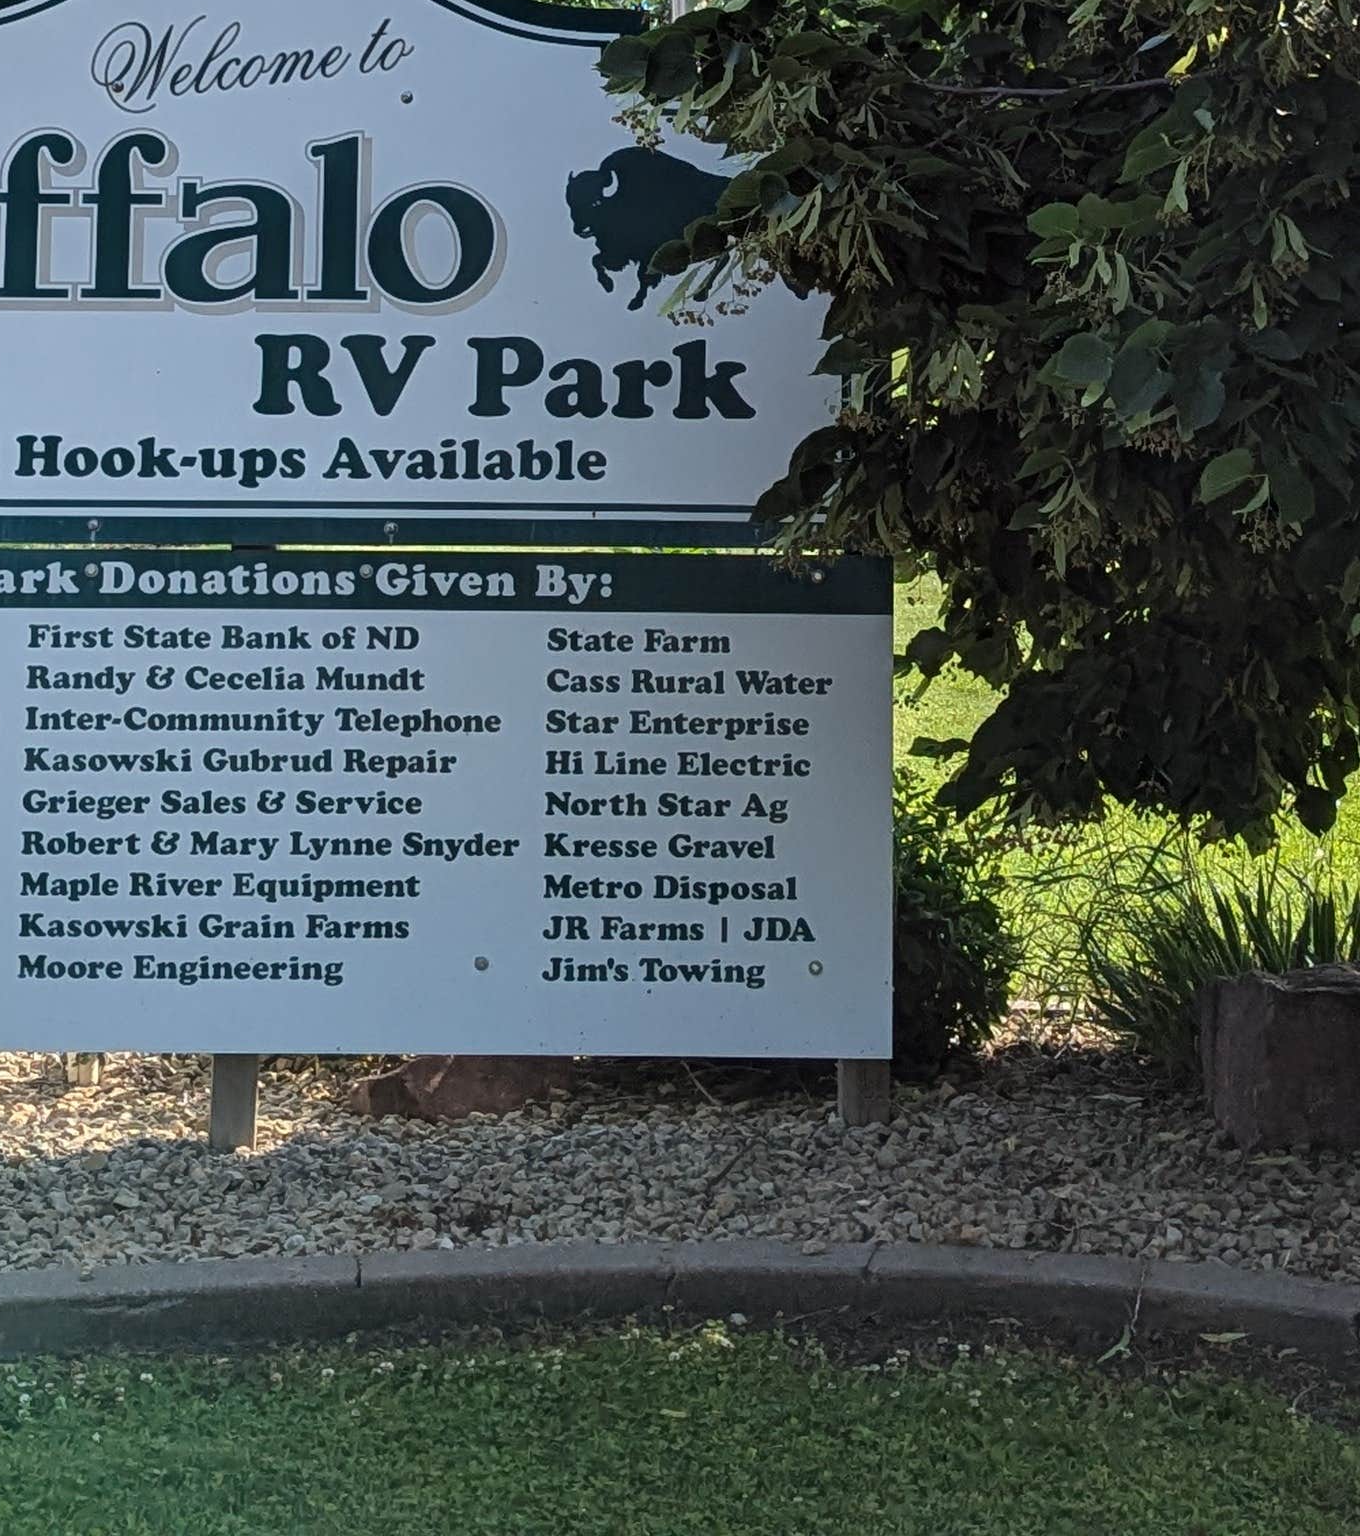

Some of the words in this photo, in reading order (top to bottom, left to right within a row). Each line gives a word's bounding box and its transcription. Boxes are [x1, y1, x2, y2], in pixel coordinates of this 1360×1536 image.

[90, 14, 352, 114] Welcome
[357, 17, 415, 75] to
[252, 333, 437, 417] RV
[466, 336, 757, 420] Park
[14, 434, 306, 489] Hook-ups
[322, 437, 607, 481] Available
[98, 561, 356, 596] Donations
[375, 562, 516, 597] Given
[535, 564, 612, 605] By:
[27, 623, 114, 649] First
[123, 624, 212, 650] State
[221, 625, 312, 650] Bank
[321, 625, 357, 650] of
[366, 625, 420, 650] ND
[547, 627, 634, 653] State
[643, 628, 731, 654] Farm
[26, 665, 136, 695] Randy
[145, 664, 176, 690] &
[184, 665, 306, 691] Cecelia
[315, 666, 426, 692] Mundt
[546, 668, 621, 694] Cass
[630, 669, 725, 695] Rural
[735, 670, 833, 696] Water
[25, 706, 325, 737] Inter-Community
[334, 707, 502, 738] Telephone
[545, 709, 620, 735] Star
[629, 710, 810, 741] Enterprise
[23, 747, 193, 773] Kasowski
[202, 747, 333, 773] Gubrud
[343, 748, 457, 779] Repair
[545, 750, 584, 775] Hi
[594, 750, 667, 776] Line
[677, 751, 811, 778] Electric
[22, 789, 151, 820] Grieger
[160, 789, 246, 815] Sales
[256, 789, 286, 815] &
[295, 790, 423, 815] Service
[544, 791, 648, 817] North
[657, 792, 732, 818] Star
[740, 792, 789, 824] Ag
[21, 830, 141, 856] Robert
[150, 830, 181, 856] &
[189, 830, 280, 861] Mary
[289, 830, 393, 861] Lynne
[402, 831, 520, 862] Snyder
[543, 832, 658, 858] Kresse
[668, 833, 776, 859] Gravel
[19, 871, 119, 902] Maple
[128, 872, 223, 897] River
[232, 872, 421, 903] Equipment
[543, 874, 643, 899] Metro
[653, 874, 798, 906] Disposal
[18, 912, 188, 938] Kasowski
[198, 913, 296, 939] Grain
[305, 914, 410, 939] Farms
[542, 915, 591, 941] JR
[600, 915, 705, 941] Farms
[743, 916, 817, 943] JDA
[17, 954, 123, 980] Moore
[133, 954, 344, 985] Engineering
[541, 957, 629, 982] Jim's
[638, 957, 766, 986] Towing
